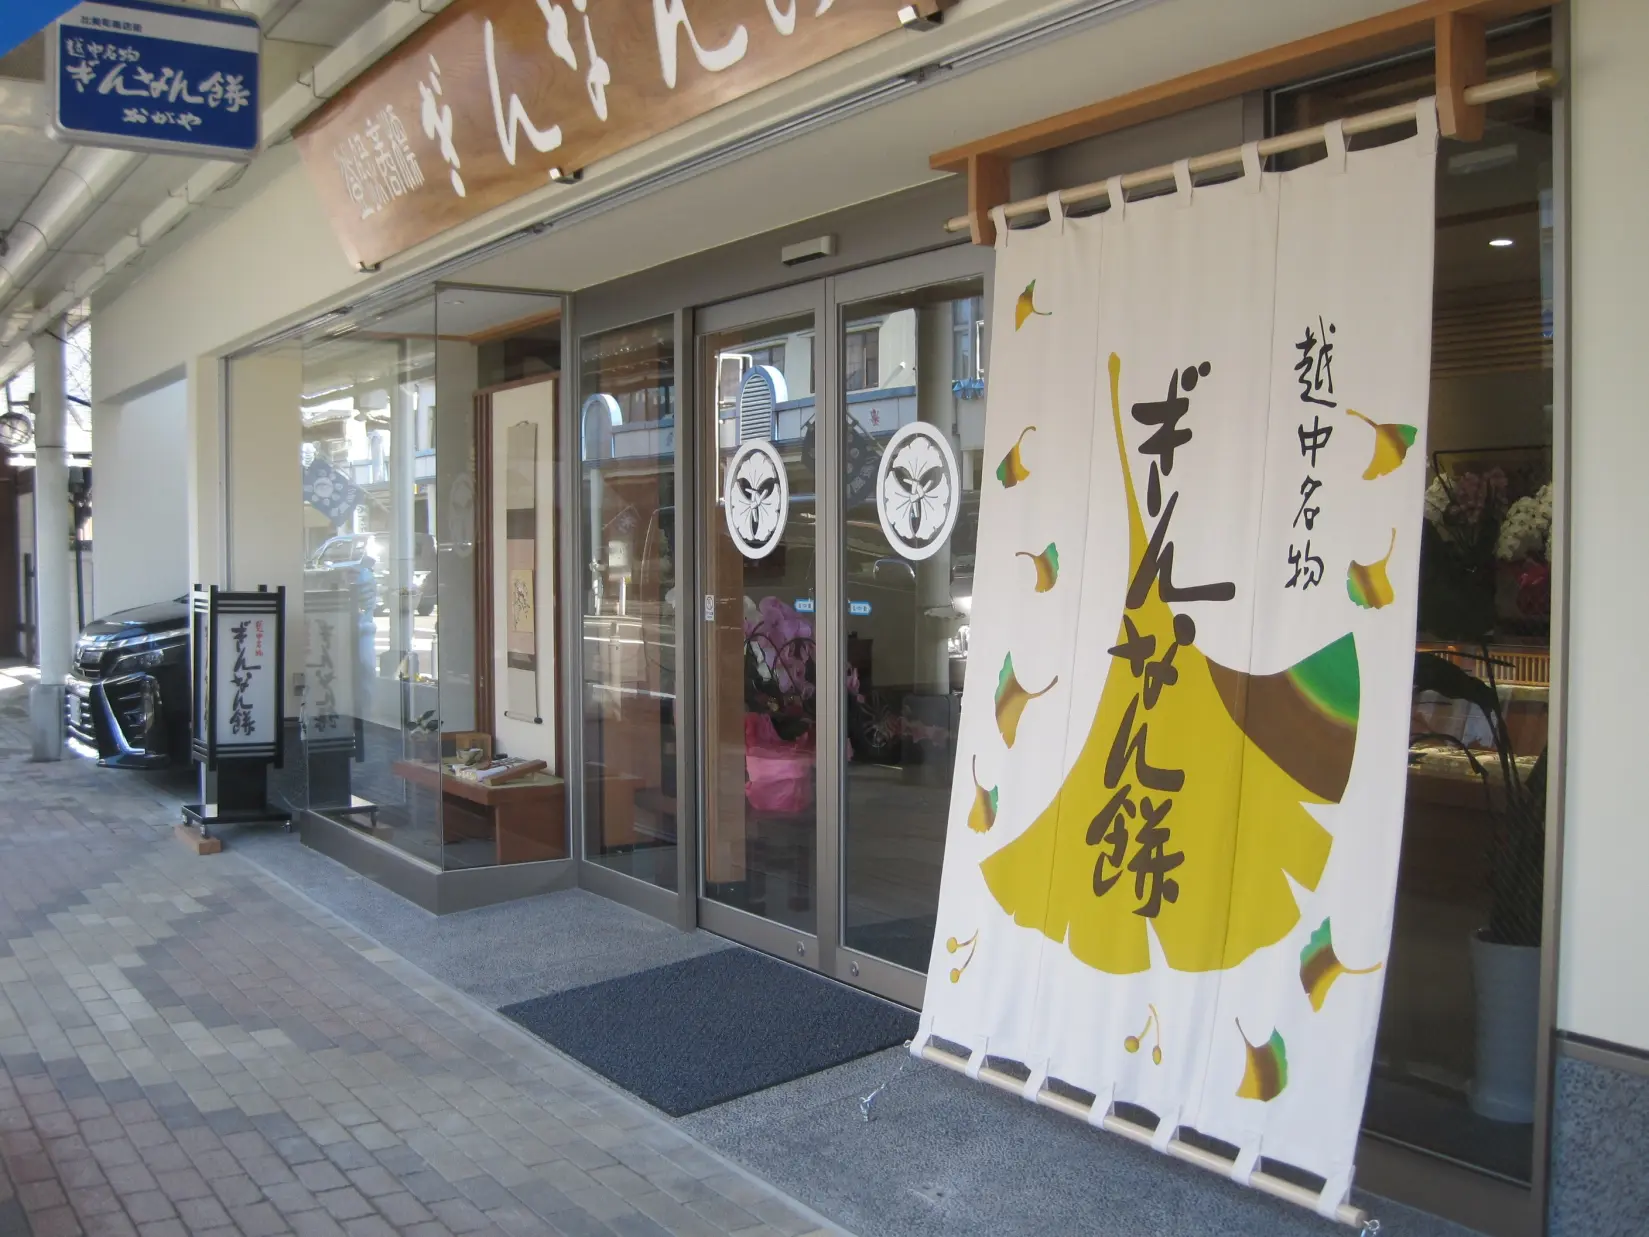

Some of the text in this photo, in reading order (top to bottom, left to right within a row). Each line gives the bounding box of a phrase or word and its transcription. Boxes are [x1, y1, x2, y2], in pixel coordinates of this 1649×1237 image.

[65, 58, 251, 112] ぎんなん餅
[66, 38, 140, 62] 越中名物
[418, 0, 834, 197] ぎんなん
[122, 107, 202, 131] おがや
[1284, 315, 1338, 591] 越中名物
[229, 620, 261, 736] ぎんなん餅
[1085, 361, 1236, 919] ぎんなん餅
